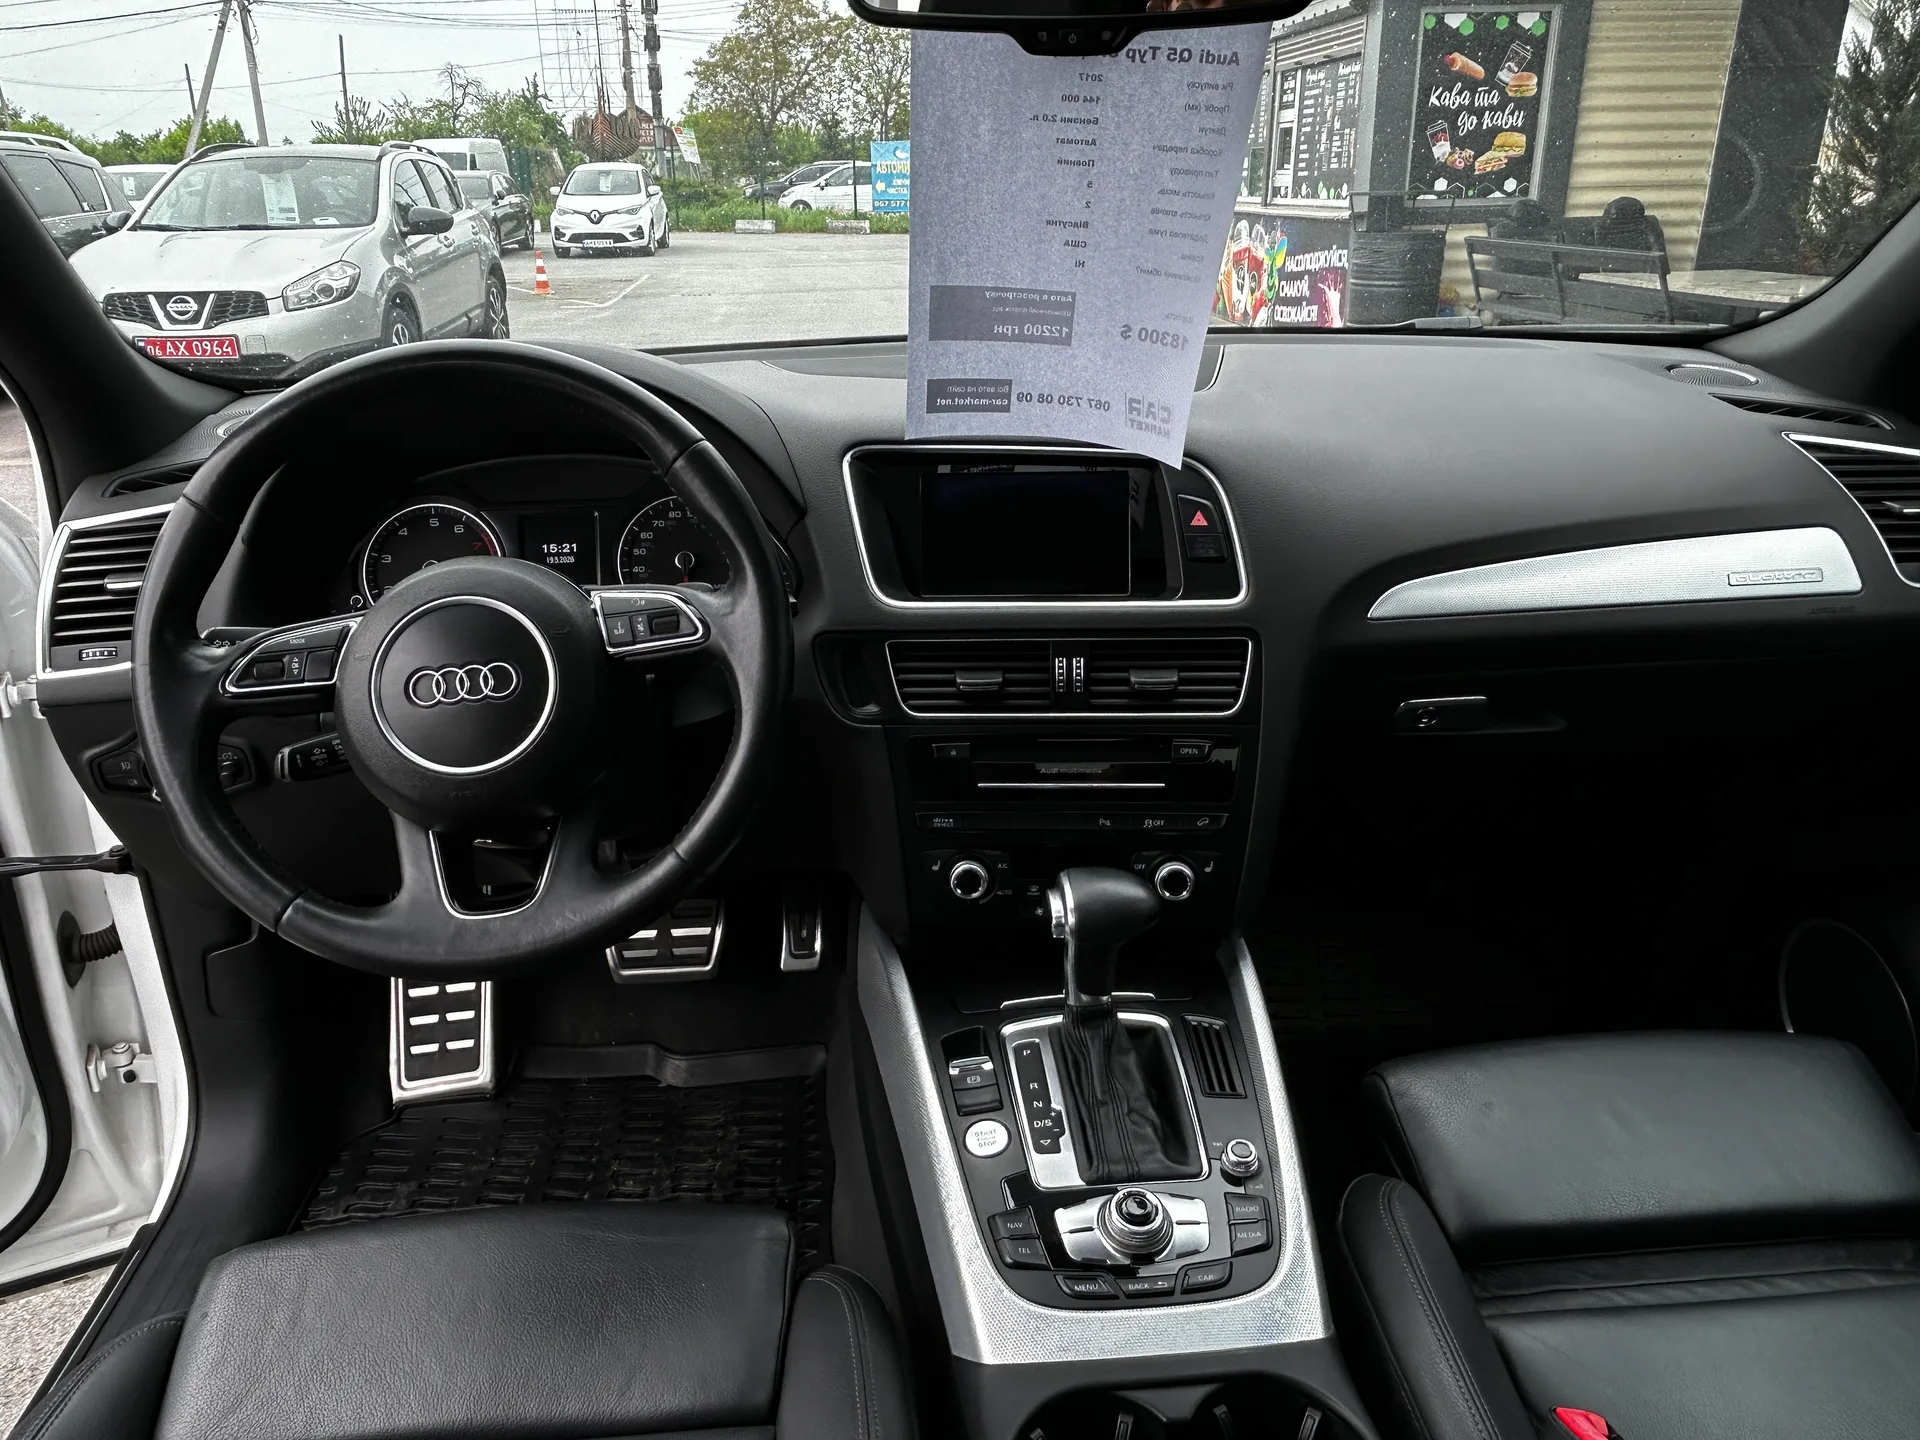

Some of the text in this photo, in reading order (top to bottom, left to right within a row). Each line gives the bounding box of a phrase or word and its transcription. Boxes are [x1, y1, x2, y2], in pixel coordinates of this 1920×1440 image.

[1428, 82, 1472, 109] Кава
[1458, 102, 1525, 136] до кави
[166, 341, 190, 356] AX
[192, 340, 233, 356] 0964
[429, 518, 440, 527] 5
[398, 528, 408, 536] 4
[454, 525, 464, 533] 6
[472, 542, 482, 550] 7
[542, 543, 577, 554] 15:21
[381, 554, 392, 563] 3
[1180, 747, 1198, 755] OPEN
[1030, 1082, 1039, 1090] R
[1034, 1119, 1053, 1128] D/S
[1235, 1205, 1259, 1213] RADIO
[1074, 1283, 1099, 1292] MENU
[1128, 1282, 1149, 1291] BACK
